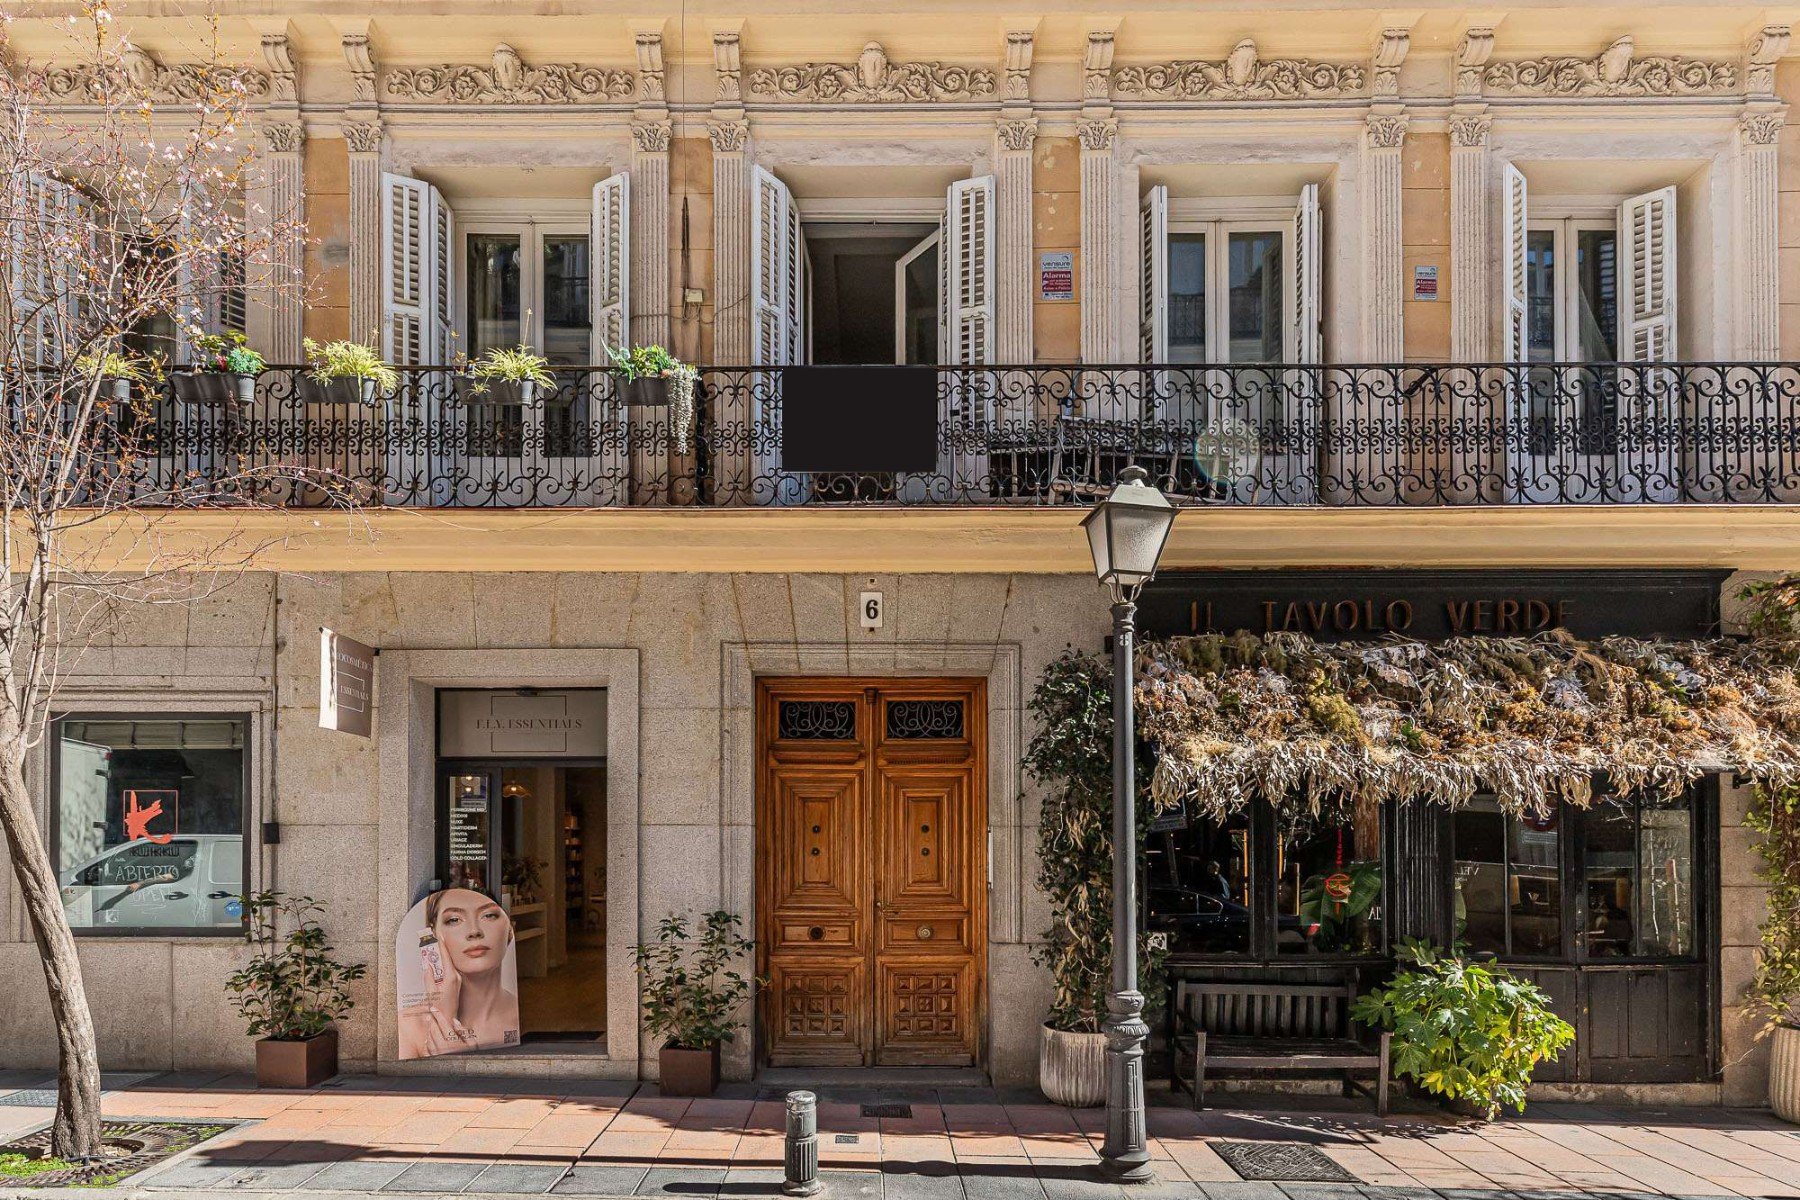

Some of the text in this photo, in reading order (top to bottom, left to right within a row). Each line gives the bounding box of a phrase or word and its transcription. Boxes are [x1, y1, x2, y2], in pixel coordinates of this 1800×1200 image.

[865, 599, 879, 620] 6
[1190, 600, 1577, 632] IL TAVOLO VERDE
[508, 719, 583, 729] ESSENTIALS
[115, 865, 180, 882] ABIERTO
